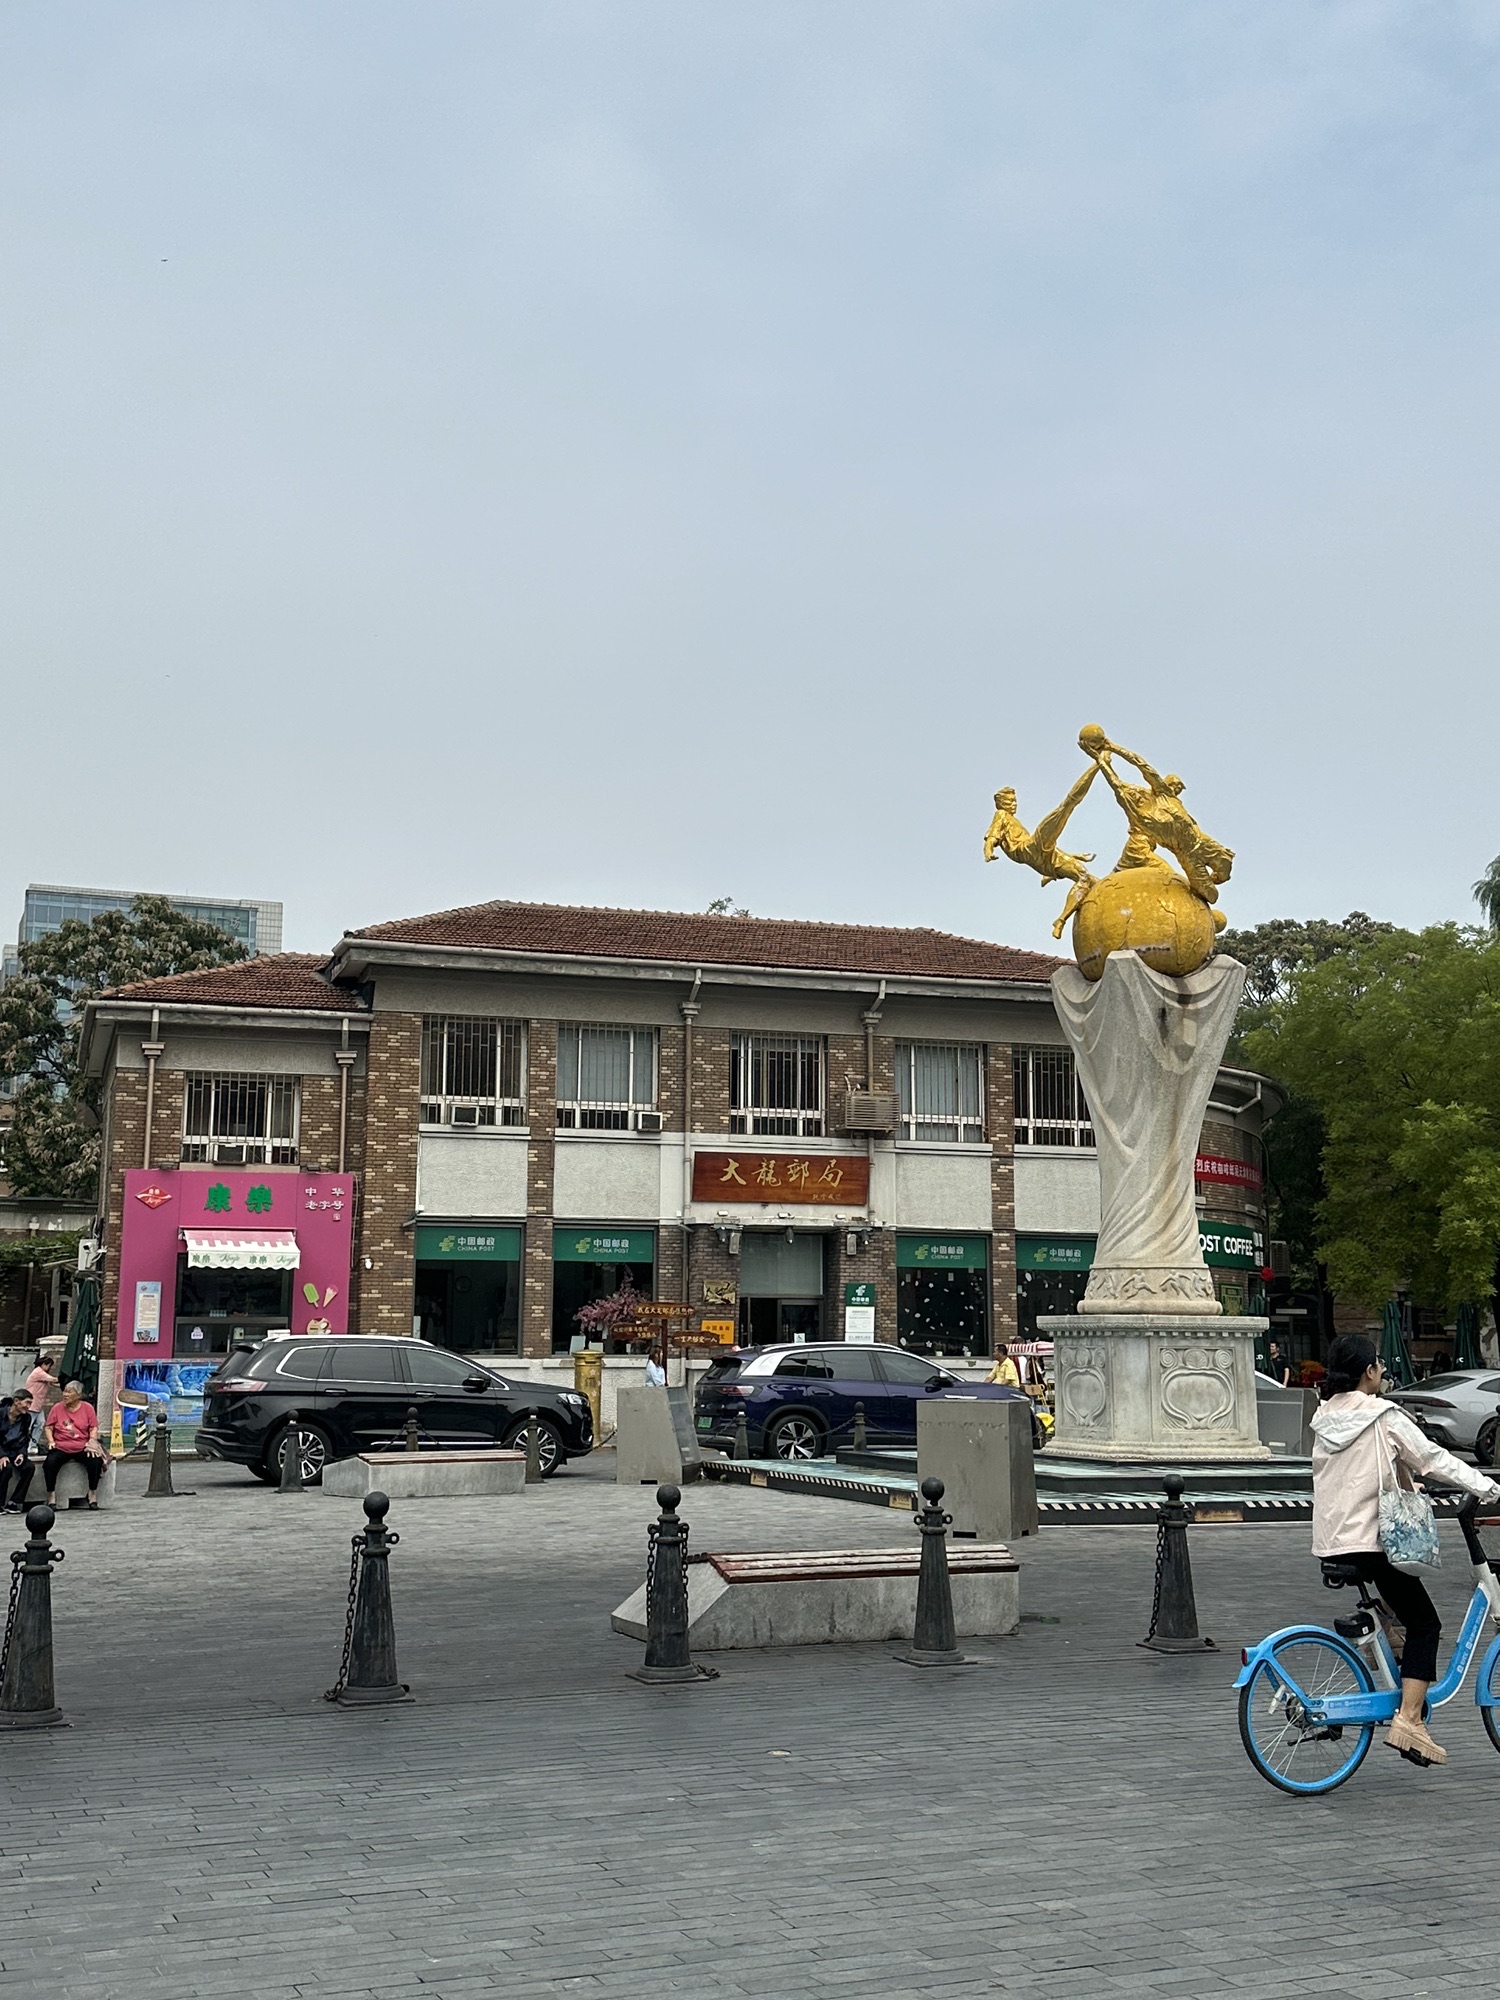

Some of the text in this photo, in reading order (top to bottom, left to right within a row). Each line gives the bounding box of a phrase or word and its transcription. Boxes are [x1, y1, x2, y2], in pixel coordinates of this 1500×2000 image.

[305, 1200, 345, 1210] 老字号
[457, 1236, 495, 1247] 中国邮政
[593, 1238, 630, 1248] 中国邮政
[1223, 1236, 1253, 1257] COFFEE
[930, 1245, 964, 1255] 中国邮政
[1050, 1248, 1082, 1258] 中国邮政
